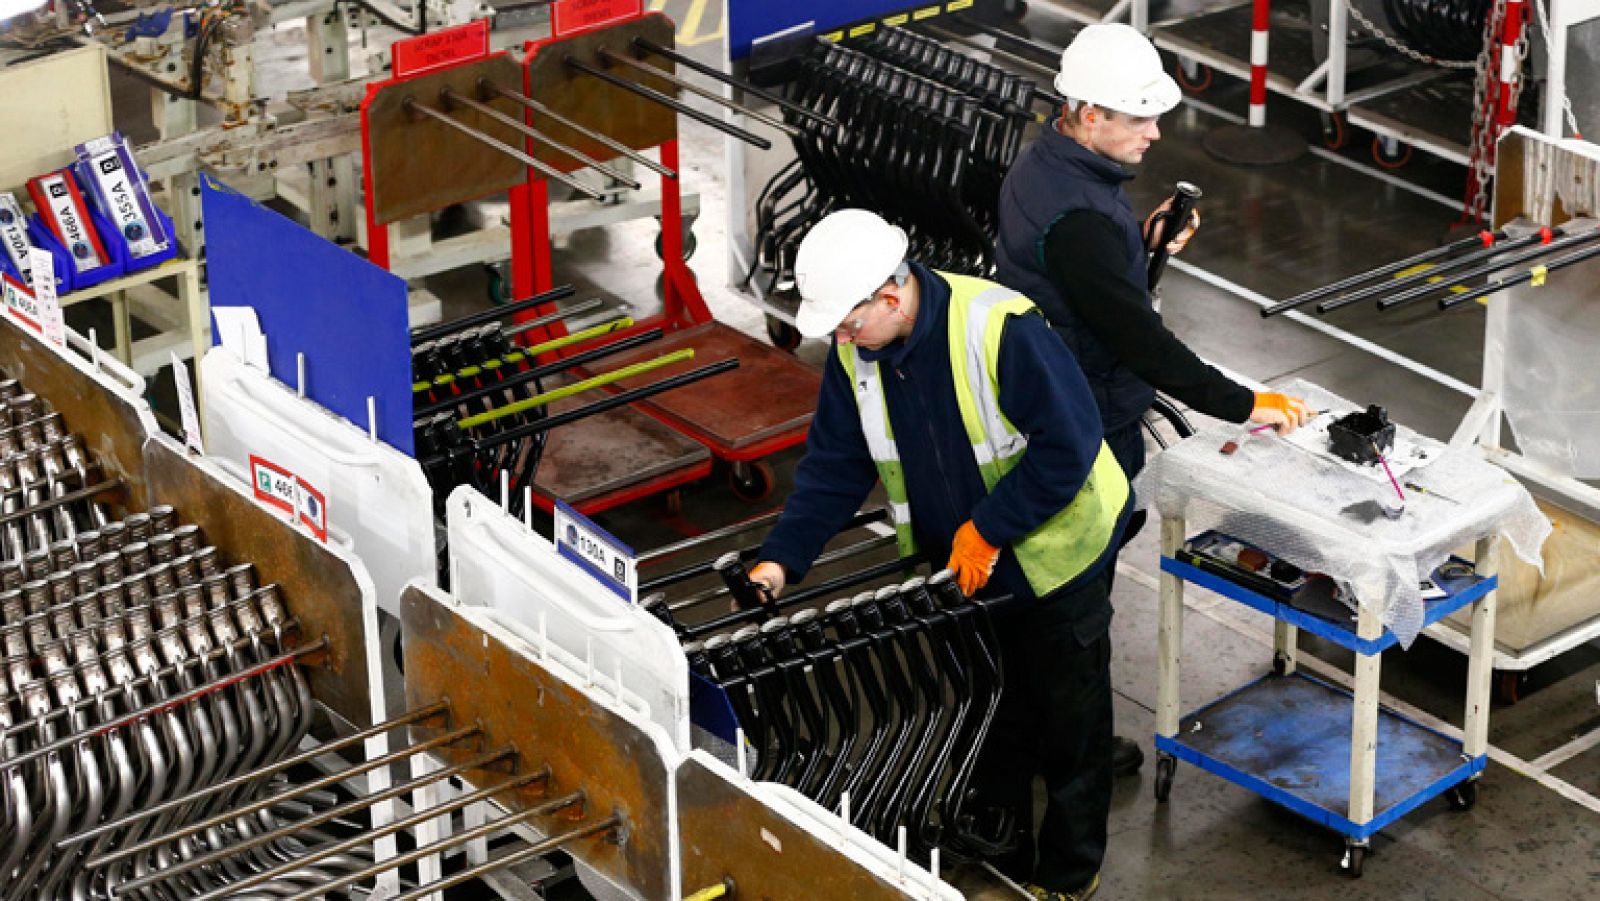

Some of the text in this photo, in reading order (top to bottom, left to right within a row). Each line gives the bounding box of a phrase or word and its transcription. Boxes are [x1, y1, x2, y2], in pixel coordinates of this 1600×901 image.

[111, 180, 137, 222] 355A
[60, 206, 80, 240] 466A
[7, 226, 28, 259] 130A
[581, 536, 606, 565] 130A
